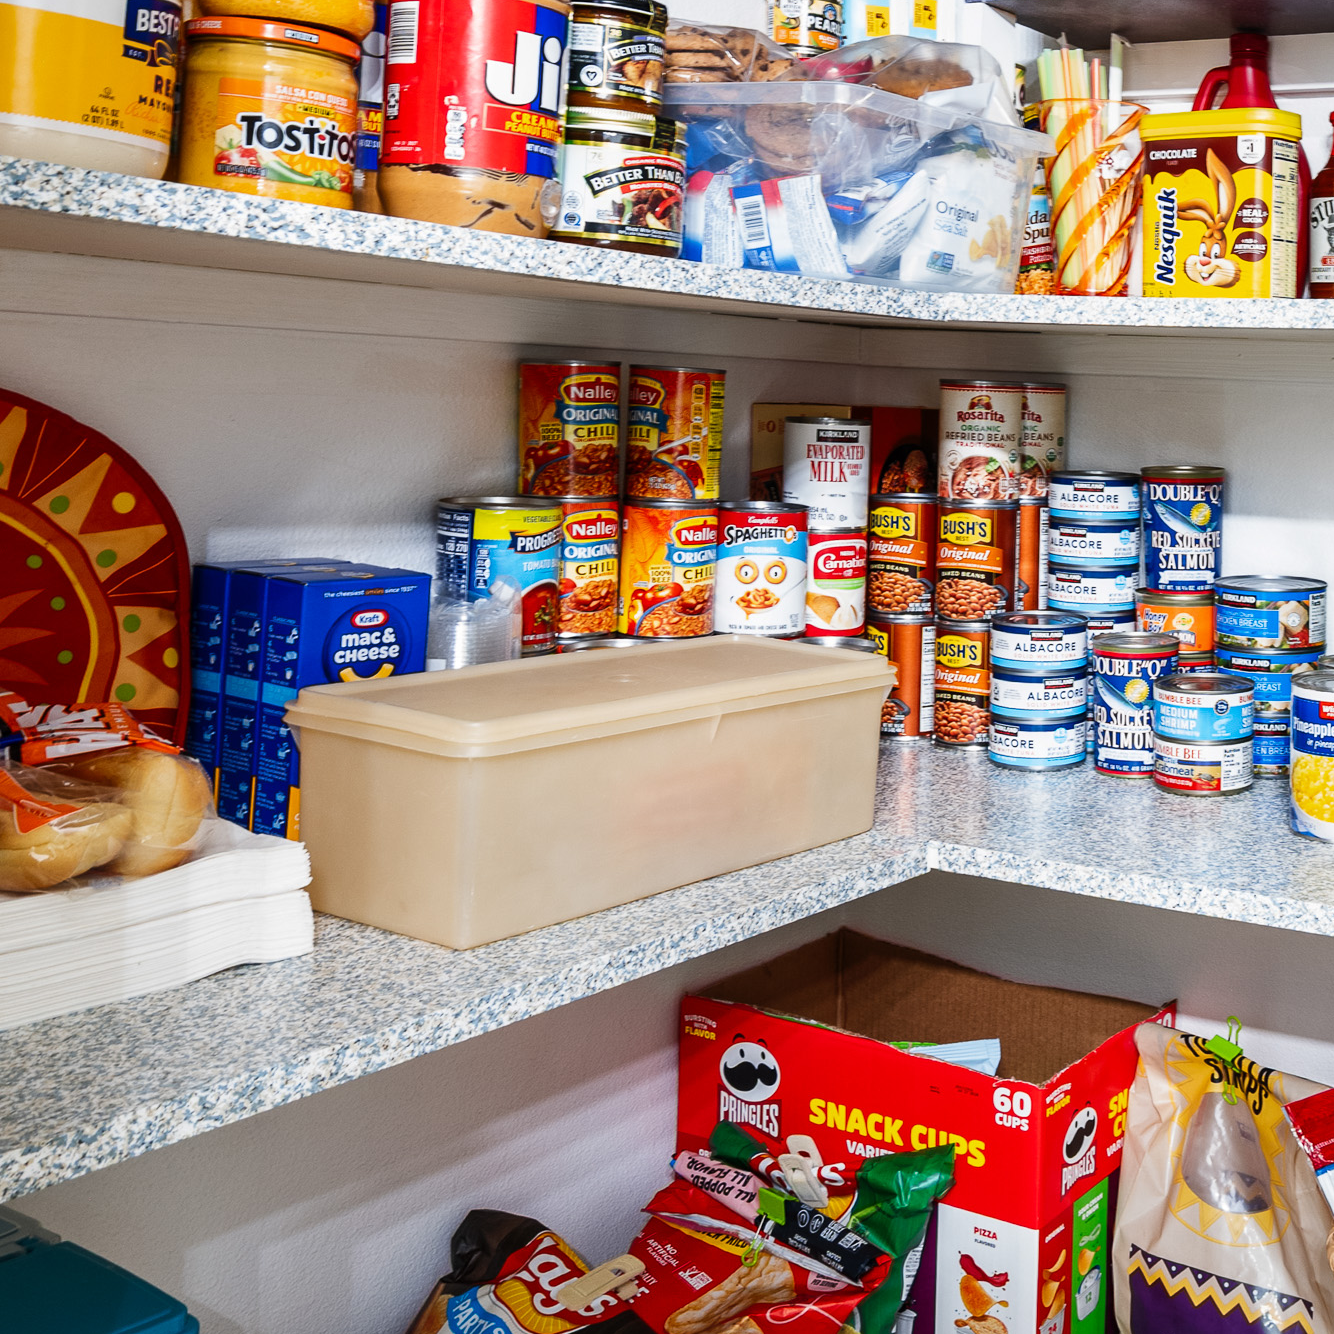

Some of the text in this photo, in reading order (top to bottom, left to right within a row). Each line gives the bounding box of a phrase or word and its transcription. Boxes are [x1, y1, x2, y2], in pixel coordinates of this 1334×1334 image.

[136, 8, 174, 35] BEST
[239, 114, 357, 165] TOSTITOS
[1149, 148, 1198, 161] CHOCOLATE
[589, 165, 674, 191] BETTER THAN
[935, 200, 980, 224] Original
[933, 218, 969, 239] Sea Salt
[1155, 187, 1178, 285] Nesquik
[569, 385, 618, 401] Nalley
[562, 406, 618, 423] ORIGINAL
[956, 409, 1005, 424] Rosarita
[573, 424, 616, 440] CHILI
[817, 429, 860, 440] KIRKLAND
[960, 424, 1001, 433] ORGANIC
[945, 432, 1017, 443] REFRIED BEANS
[1023, 432, 1055, 443] BEANS
[805, 443, 866, 460] EVAPORATED
[808, 460, 848, 483] MILK
[1059, 493, 1120, 505] ALBACORE
[571, 522, 618, 538] Nalley
[870, 513, 912, 534] BUSH'S
[942, 521, 988, 539] BUSH'S
[1151, 529, 1221, 548] RED SOCKEYE
[564, 543, 618, 559] ORIGINAL
[939, 546, 991, 562] Original
[1158, 552, 1216, 569] SALMON
[575, 561, 615, 577] CHILI
[1222, 593, 1257, 604] KIRKLAND
[358, 612, 382, 625] Kraft
[1238, 618, 1268, 629] BREAST
[340, 627, 396, 648] mac &
[333, 642, 401, 664] cheese
[936, 643, 978, 661] BUSH'S
[1014, 641, 1077, 653] ALBACORE
[1231, 657, 1271, 667] KIRKLAND
[1027, 687, 1084, 701] ALBACORE
[1157, 692, 1202, 705] BUMBLE BEE
[1159, 705, 1198, 719] MEDIUM
[1160, 716, 1197, 730] SHRIMP
[684, 1025, 717, 1042] FLAVOR
[992, 1086, 1033, 1118] 60
[1045, 1095, 1072, 1118] FLAVOR
[719, 1090, 781, 1139] PRINGLES
[808, 1098, 905, 1147] SNACK
[993, 1112, 1031, 1131] CUPS
[1060, 1147, 1097, 1197] PRINGLES
[973, 1226, 998, 1241] PIZZA
